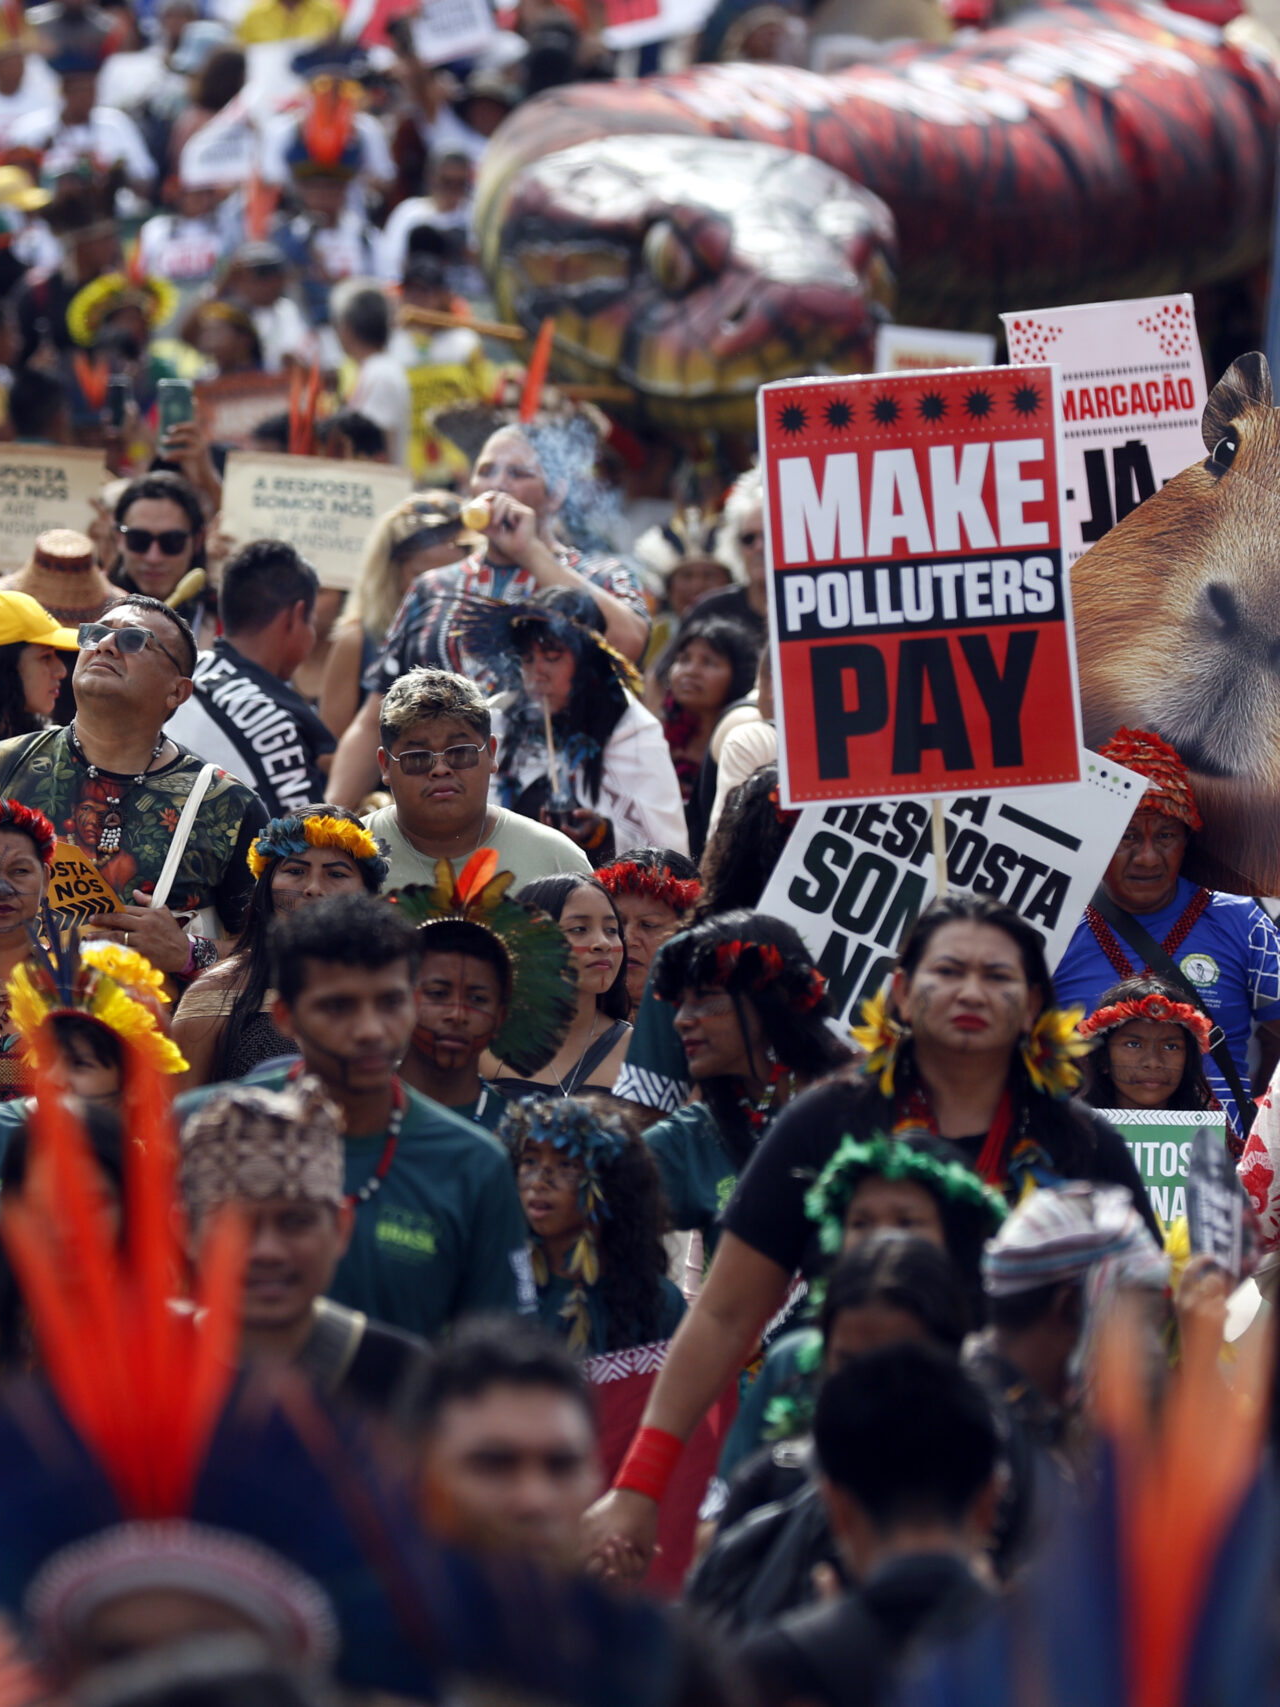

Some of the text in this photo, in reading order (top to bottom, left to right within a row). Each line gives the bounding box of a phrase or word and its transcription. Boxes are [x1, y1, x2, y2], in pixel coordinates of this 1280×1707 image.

[253, 477, 373, 499] A RESPOSTA
[778, 438, 1050, 565] MAKE
[3, 502, 36, 516] ARE
[253, 495, 326, 511] SOMOS
[783, 556, 1056, 633] POLLUTERS
[810, 630, 1039, 781] PAY
[54, 874, 105, 902] NÓS
